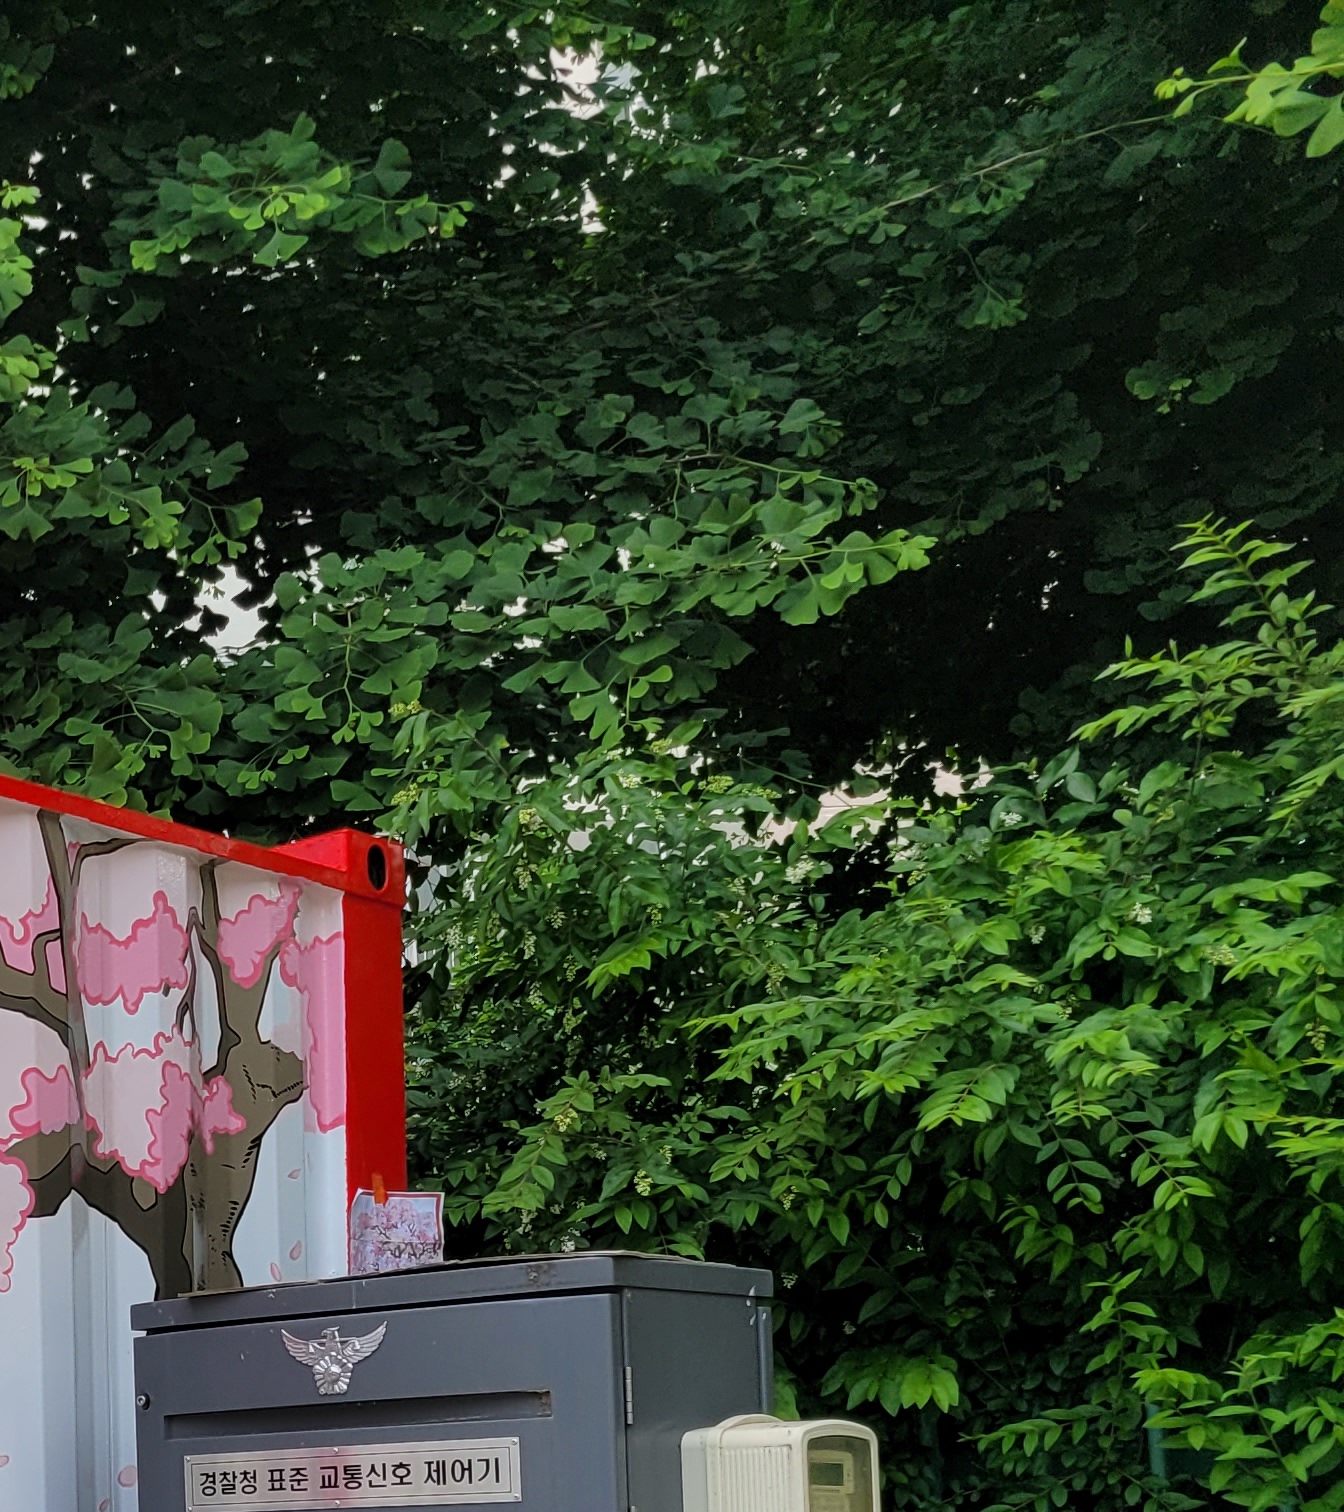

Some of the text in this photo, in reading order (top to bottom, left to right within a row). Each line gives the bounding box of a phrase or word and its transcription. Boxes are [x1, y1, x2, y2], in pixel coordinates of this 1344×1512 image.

[198, 1456, 501, 1497] 경찰청 표준 교통신호 제어기
